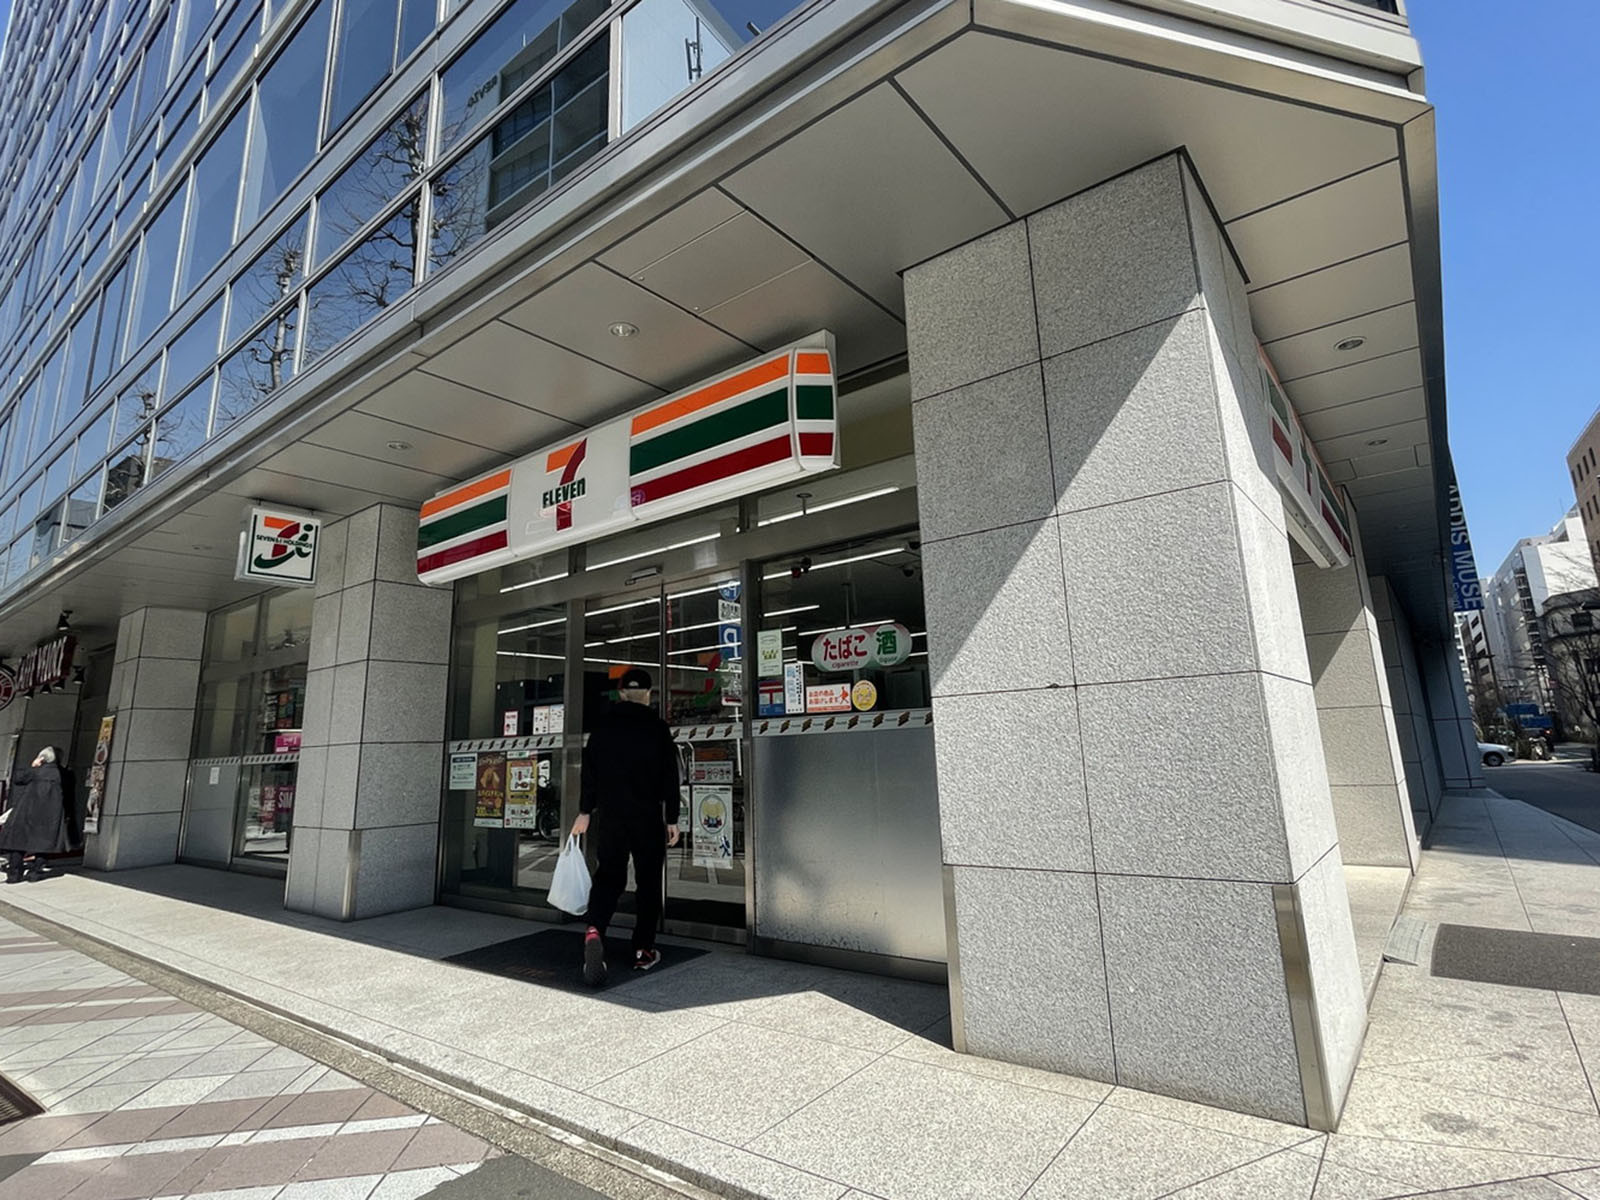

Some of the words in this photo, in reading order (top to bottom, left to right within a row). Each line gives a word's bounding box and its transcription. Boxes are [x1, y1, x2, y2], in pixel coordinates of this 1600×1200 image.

[542, 477, 586, 508] ELEVEN
[1453, 550, 1484, 609] MUSE
[822, 634, 868, 662] たばこ
[876, 630, 897, 655] 酒
